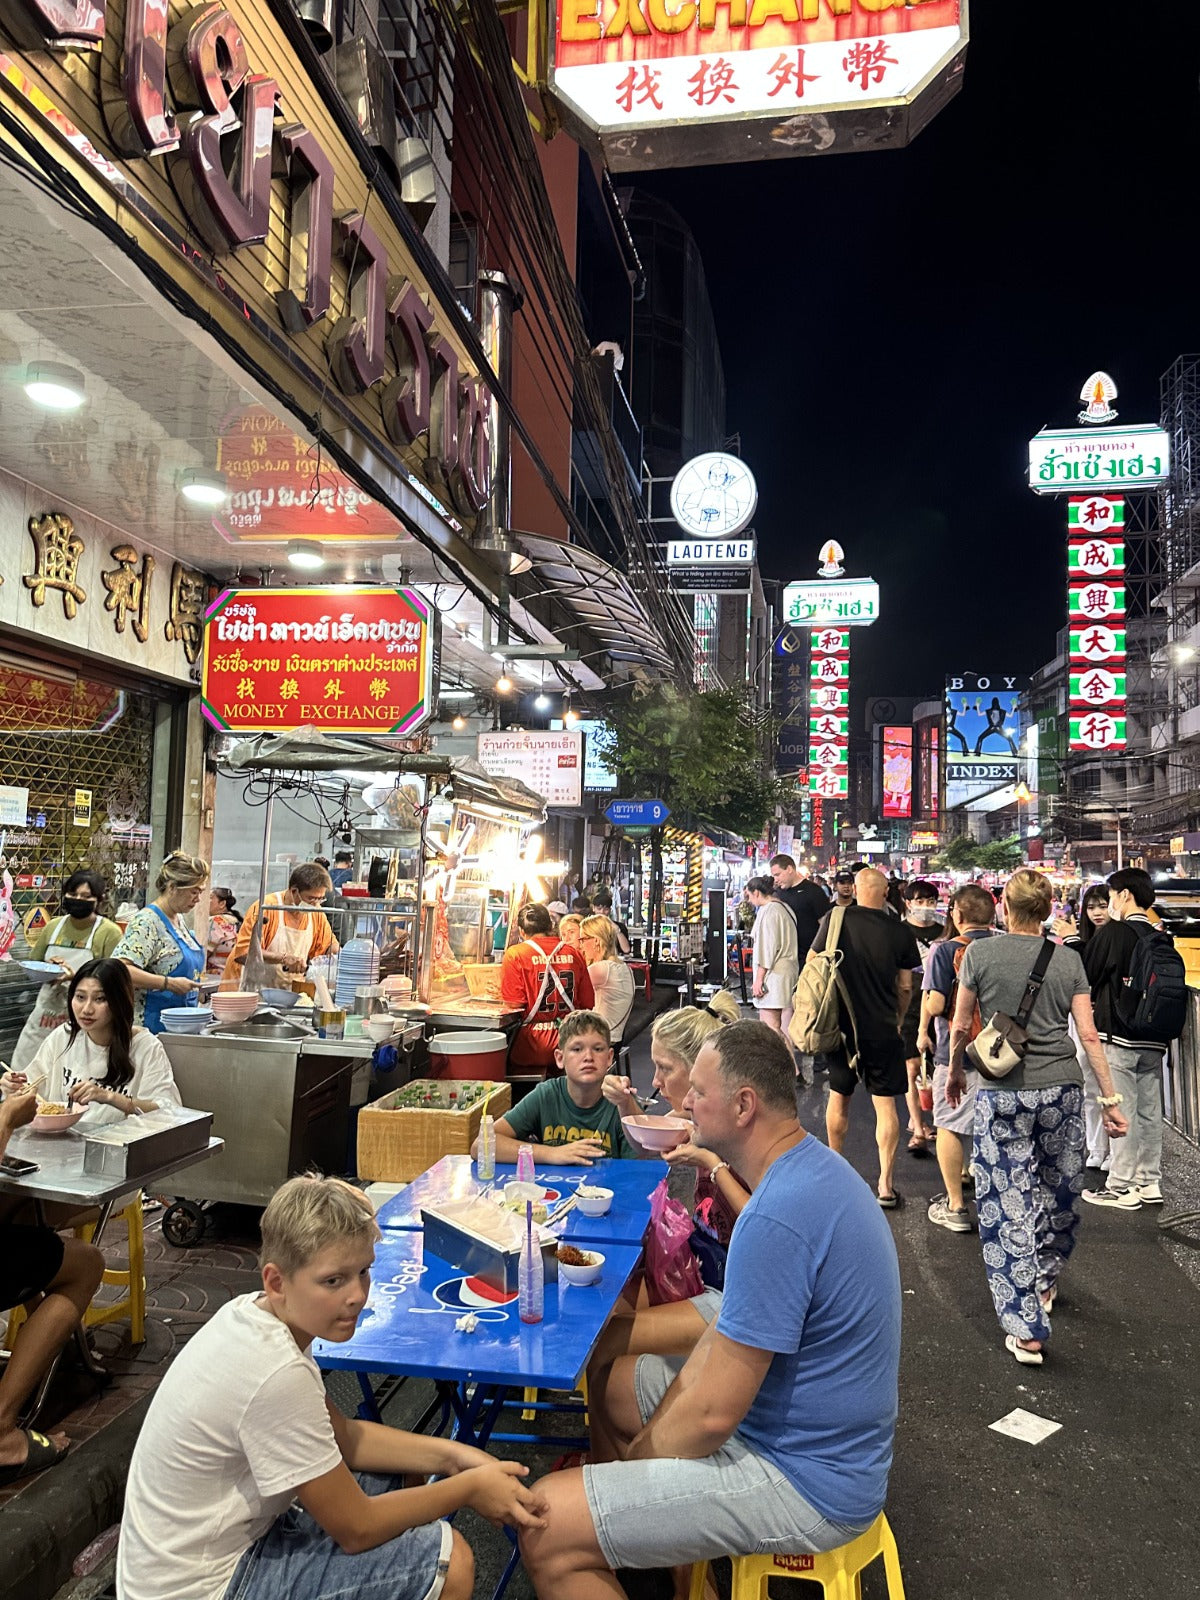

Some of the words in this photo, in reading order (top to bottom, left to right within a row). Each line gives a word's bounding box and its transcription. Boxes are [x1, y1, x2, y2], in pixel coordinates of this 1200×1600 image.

[1039, 448, 1161, 481] ฮั่วเซ่งเฮง
[673, 543, 748, 559] LAOTENG
[224, 603, 257, 617] บริษัท
[215, 615, 268, 641] ไชน่า
[1082, 501, 1112, 744] 和成興大金行
[386, 641, 418, 653] จำกัด
[212, 648, 281, 673] รับซื้อ-ขาย
[286, 652, 418, 673] เงินตราต่างประเทศ
[951, 677, 1017, 690] BOY
[223, 704, 289, 719] MONEY
[300, 705, 400, 720] EXCHANGE
[780, 744, 804, 754] UOB
[952, 765, 1016, 778] INDEX
[613, 804, 644, 813] เยาวราช
[653, 805, 661, 818] 9
